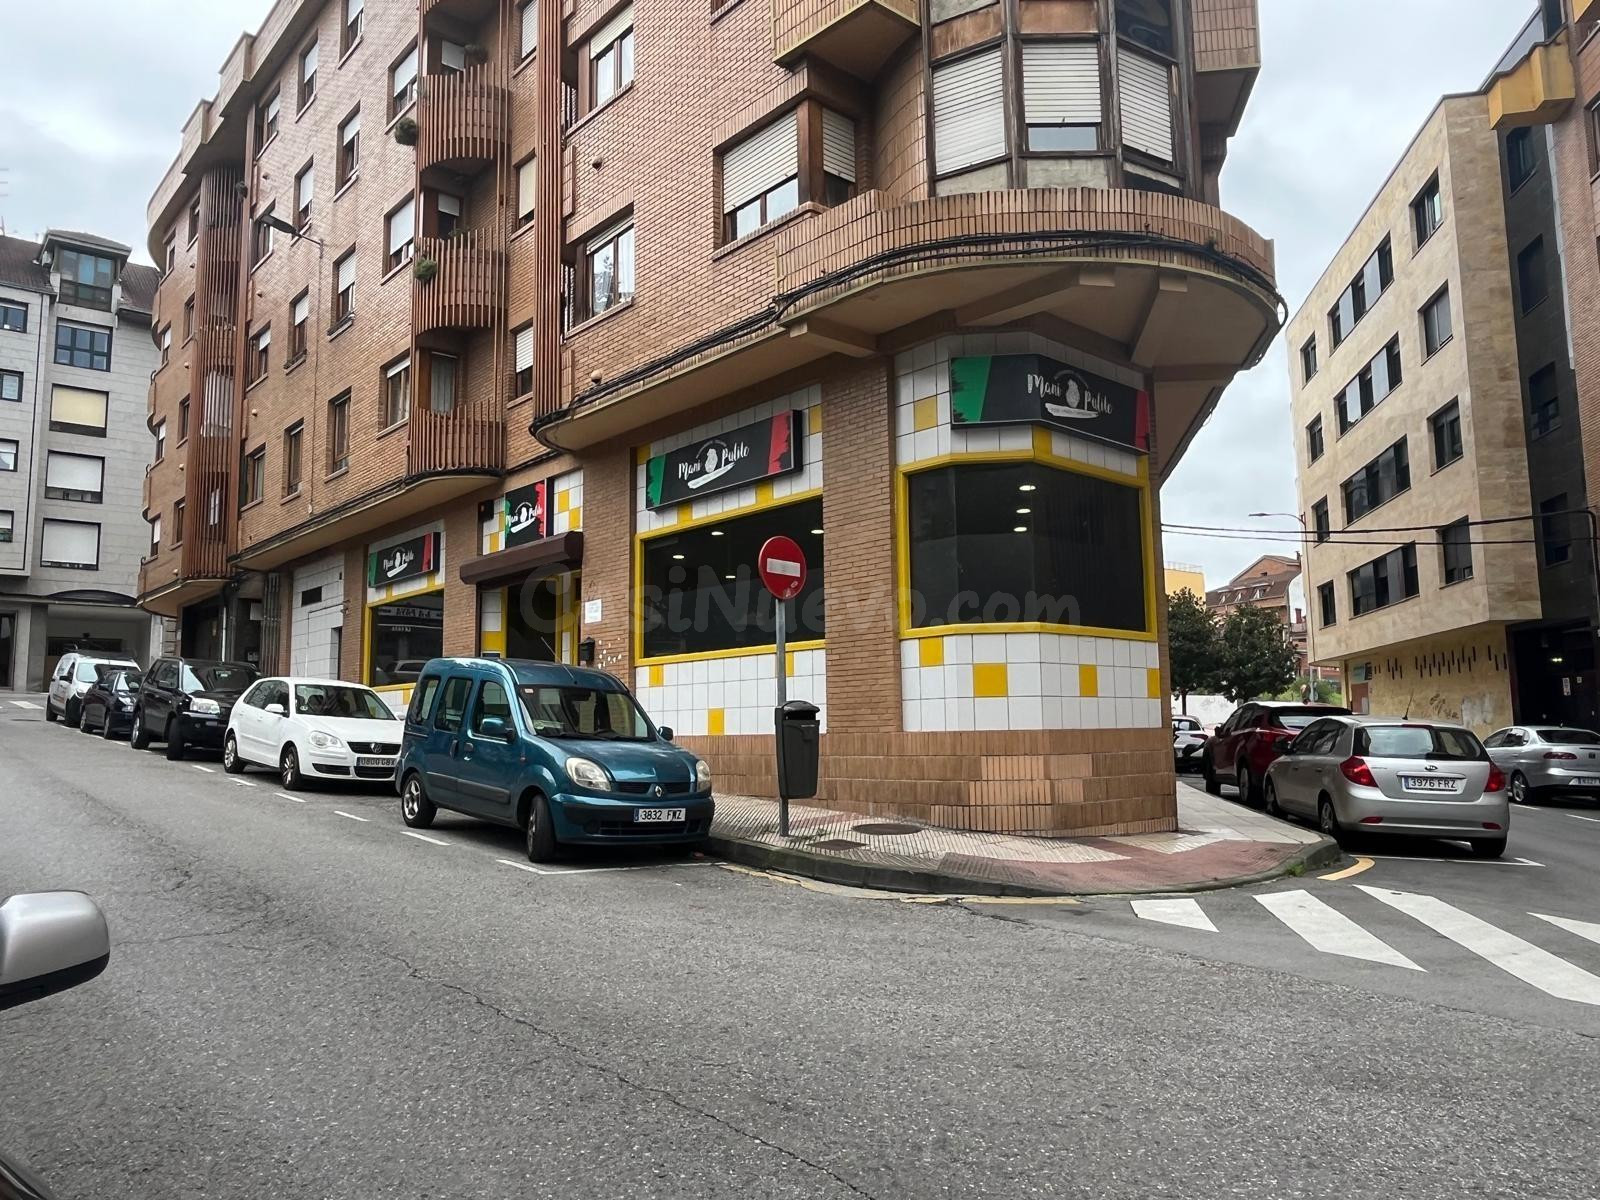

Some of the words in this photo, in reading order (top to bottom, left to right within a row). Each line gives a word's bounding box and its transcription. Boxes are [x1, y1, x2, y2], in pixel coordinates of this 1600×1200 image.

[1027, 374, 1061, 398] Mani
[678, 459, 701, 480] Mani
[1411, 779, 1434, 788] 3976
[1437, 779, 1456, 789] FRZ
[641, 810, 662, 820] 3832
